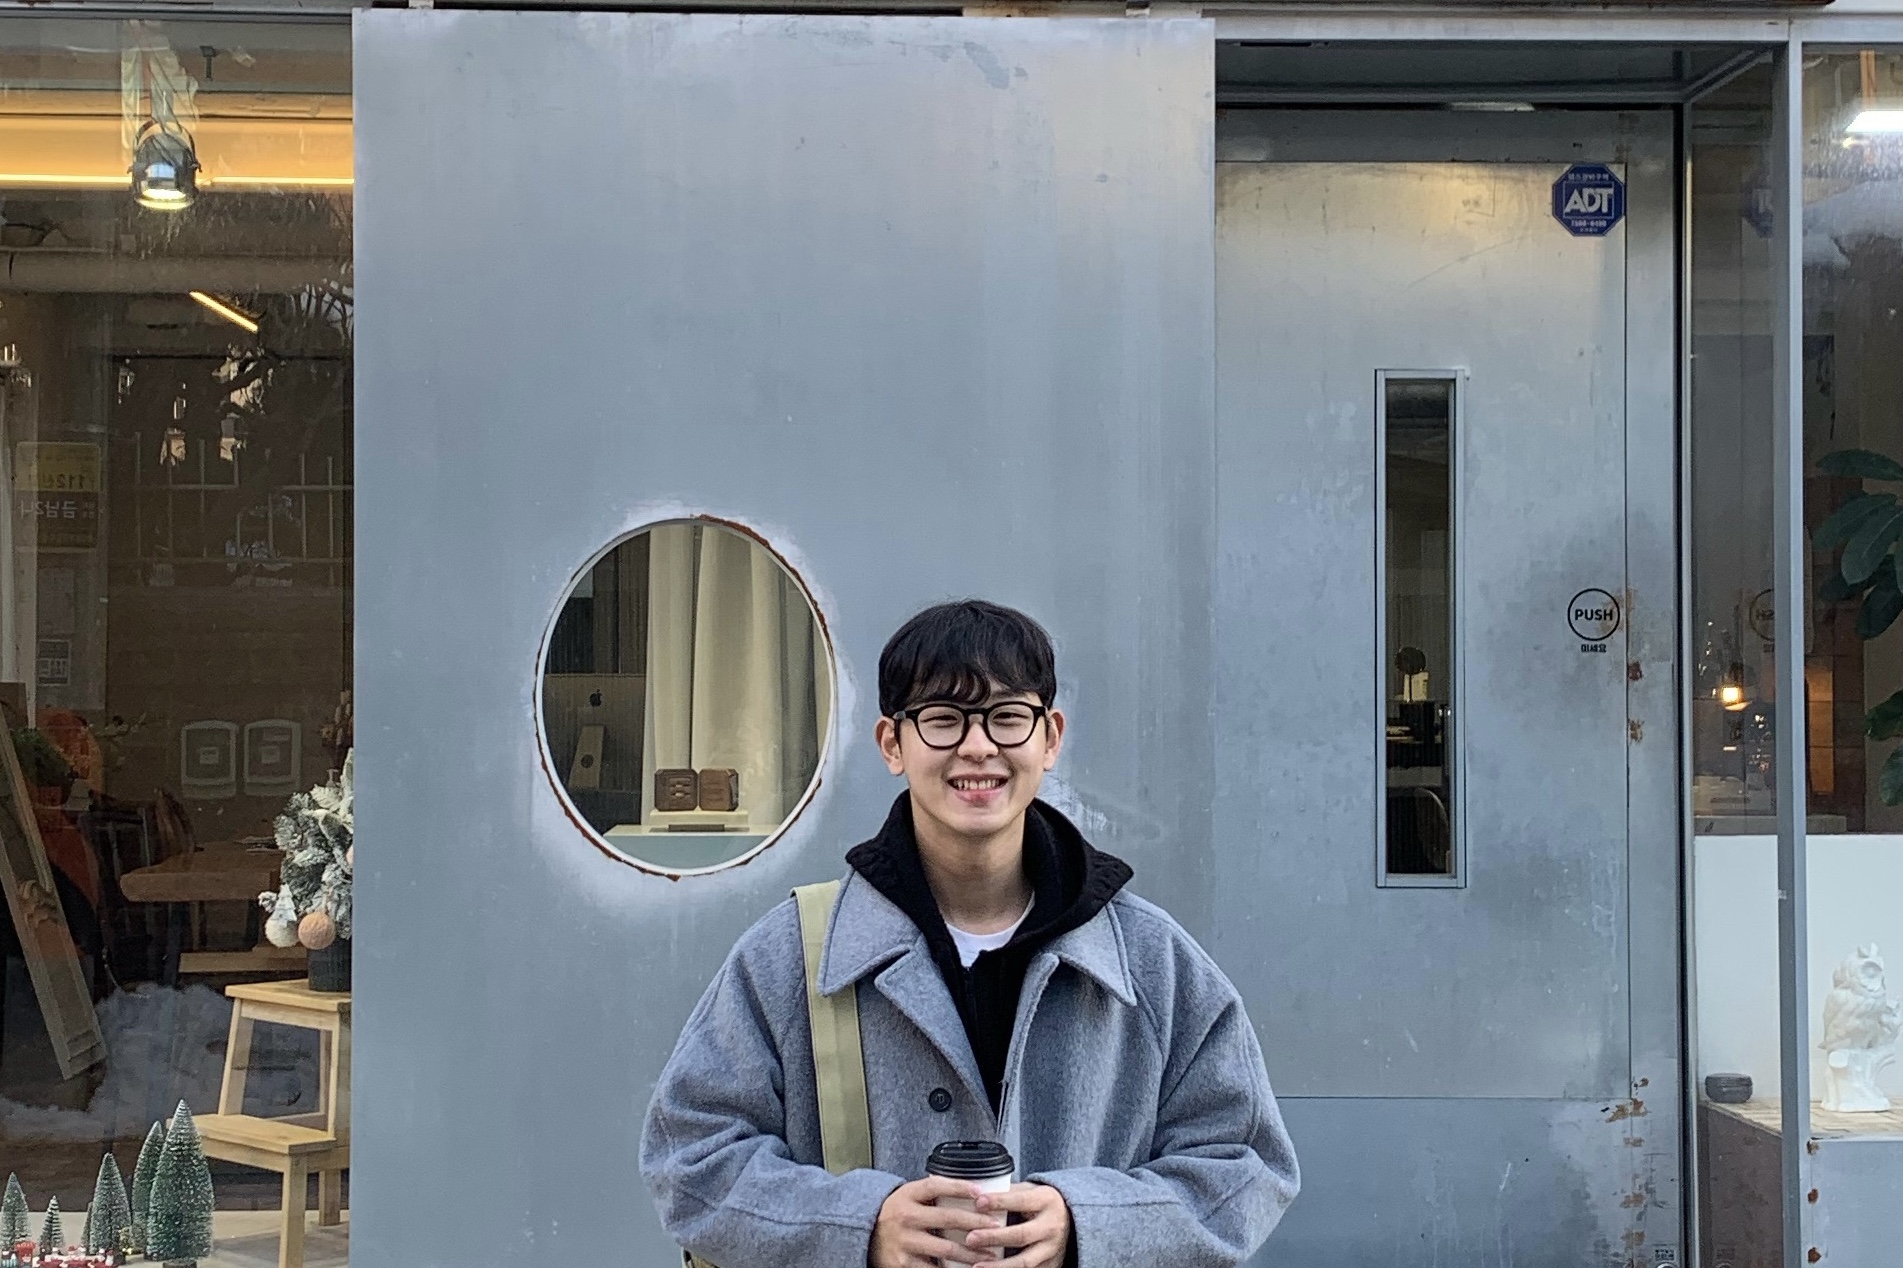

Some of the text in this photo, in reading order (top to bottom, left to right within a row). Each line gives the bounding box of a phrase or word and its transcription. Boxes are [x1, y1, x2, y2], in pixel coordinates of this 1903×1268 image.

[1563, 188, 1614, 214] ADT
[1575, 609, 1613, 621] PUSH
[1581, 644, 1607, 653] 미세요
